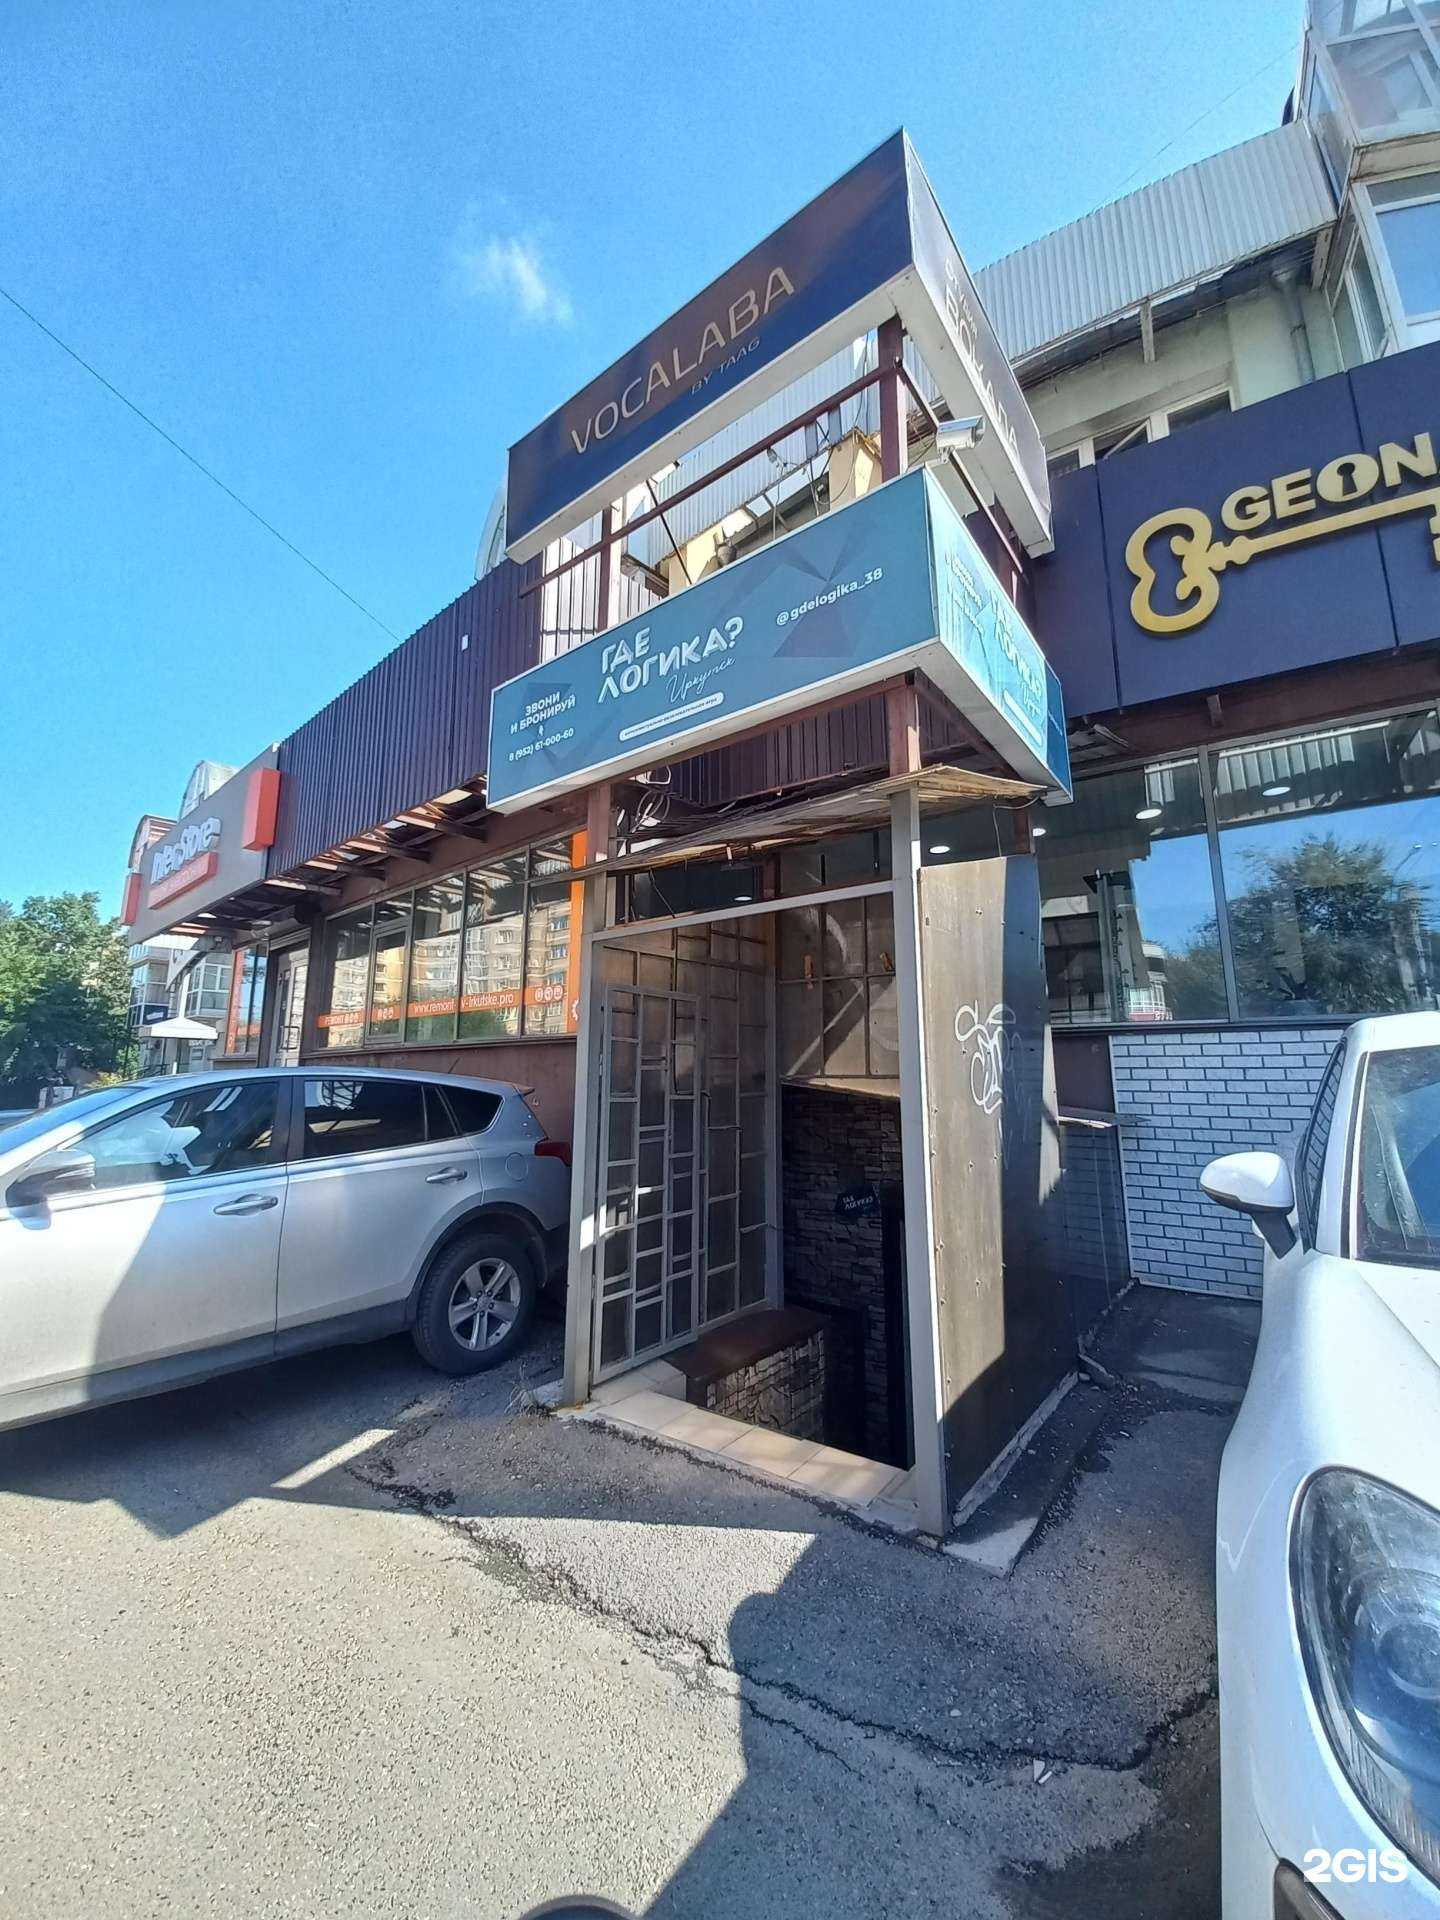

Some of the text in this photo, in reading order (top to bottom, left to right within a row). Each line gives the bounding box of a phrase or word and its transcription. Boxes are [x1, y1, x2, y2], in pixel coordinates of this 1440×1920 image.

[571, 267, 795, 454] VOCALABA
[691, 372, 713, 395] BY
[1221, 432, 1440, 531] GEON
[776, 567, 883, 626] @gdelogika_38
[598, 617, 743, 703] ЛОГИКА?
[602, 627, 650, 674] ГДЕ
[666, 657, 736, 702] Иркутск
[510, 694, 576, 734] И БРОНИРУЙ
[525, 691, 560, 716] ЗВОНИ
[515, 744, 534, 760] (952)
